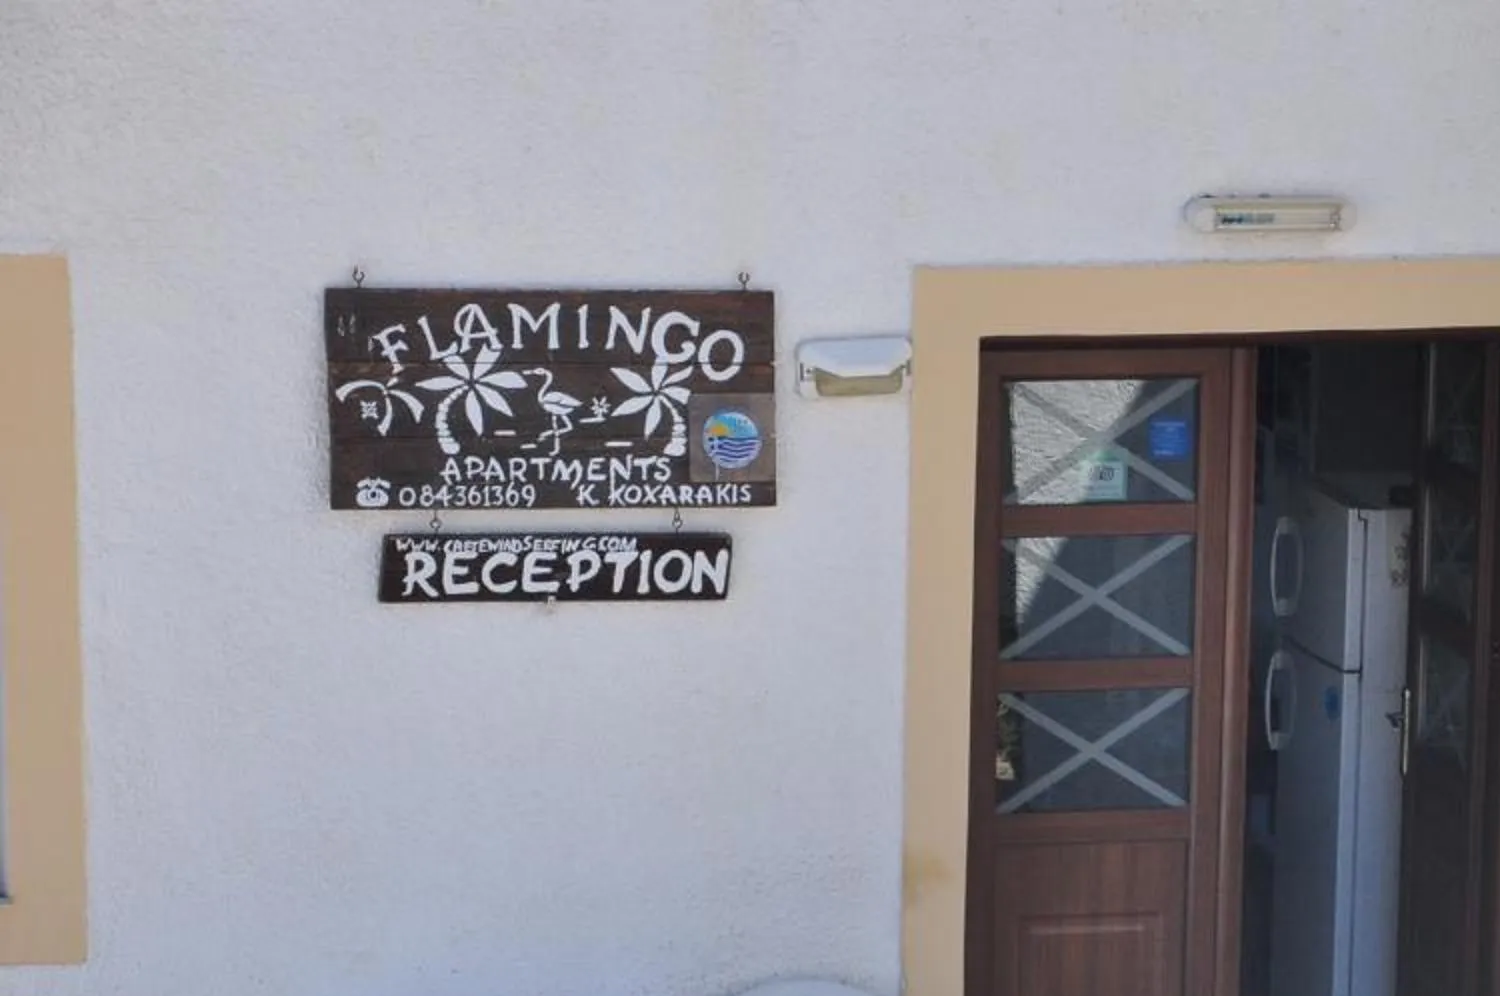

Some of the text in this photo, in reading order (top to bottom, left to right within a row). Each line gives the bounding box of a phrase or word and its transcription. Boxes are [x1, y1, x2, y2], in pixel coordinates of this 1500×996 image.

[370, 303, 745, 382] FLAMINGO
[440, 455, 672, 489] APARTMENTS
[399, 483, 536, 507] 084361369
[608, 482, 752, 506] KOXARAKIS
[402, 548, 730, 598] RECEPTION
